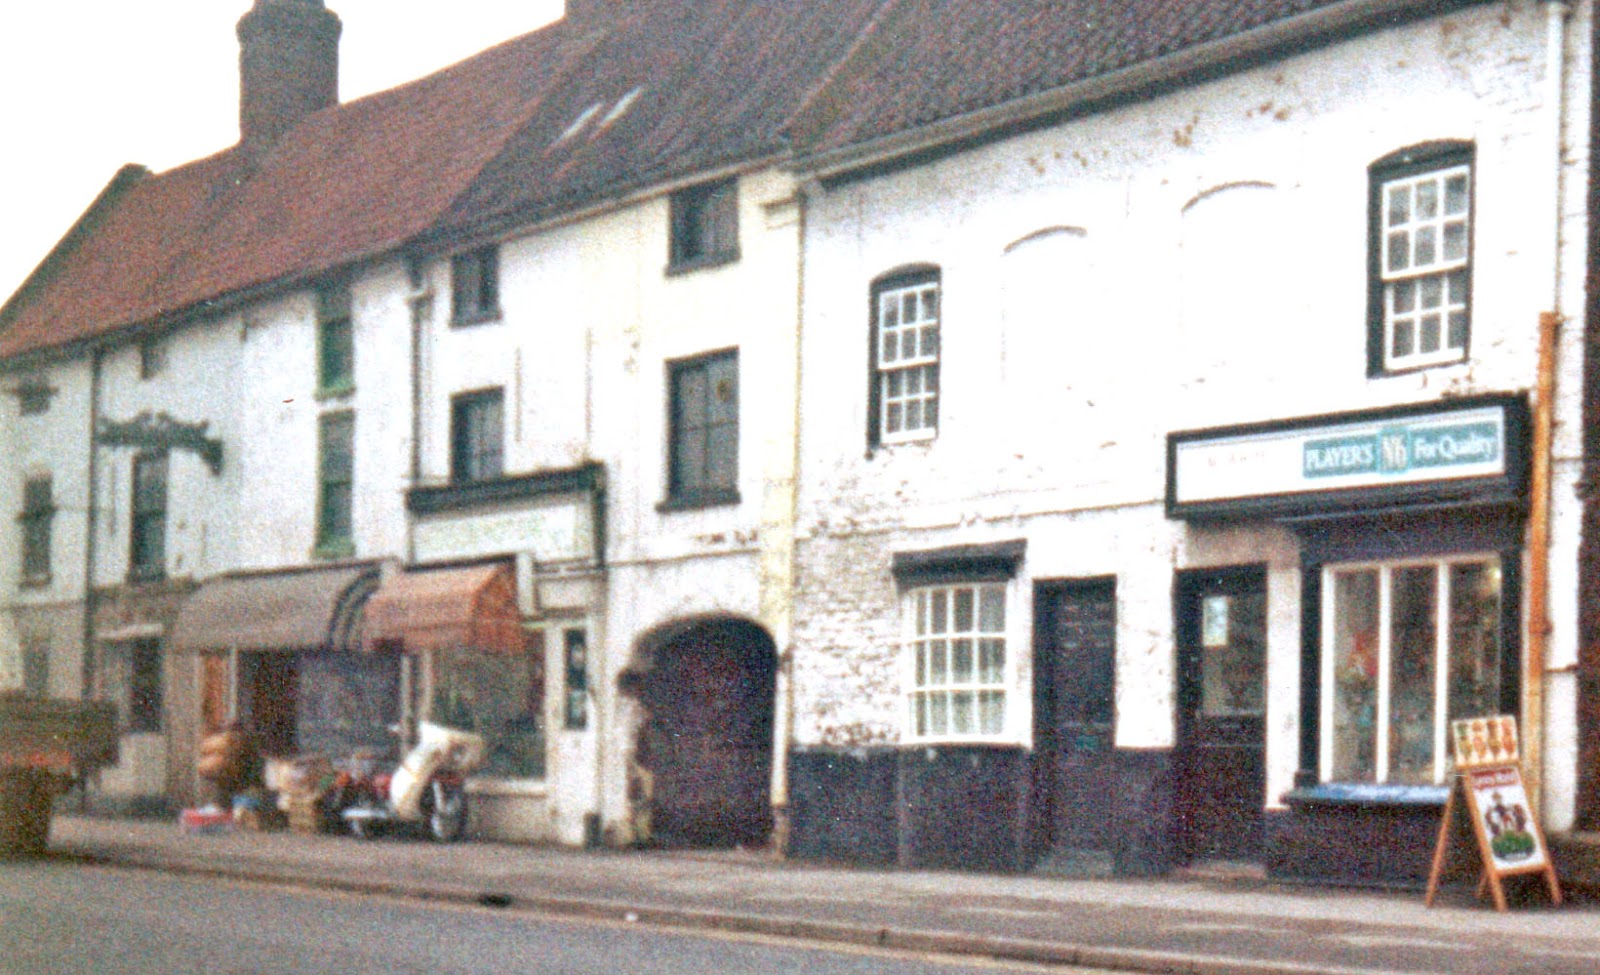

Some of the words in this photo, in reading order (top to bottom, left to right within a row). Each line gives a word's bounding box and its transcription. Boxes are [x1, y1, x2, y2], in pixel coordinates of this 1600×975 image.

[1305, 443, 1373, 471] PLAYER'S
[1414, 437, 1436, 460] For
[1438, 431, 1492, 460] Quality
